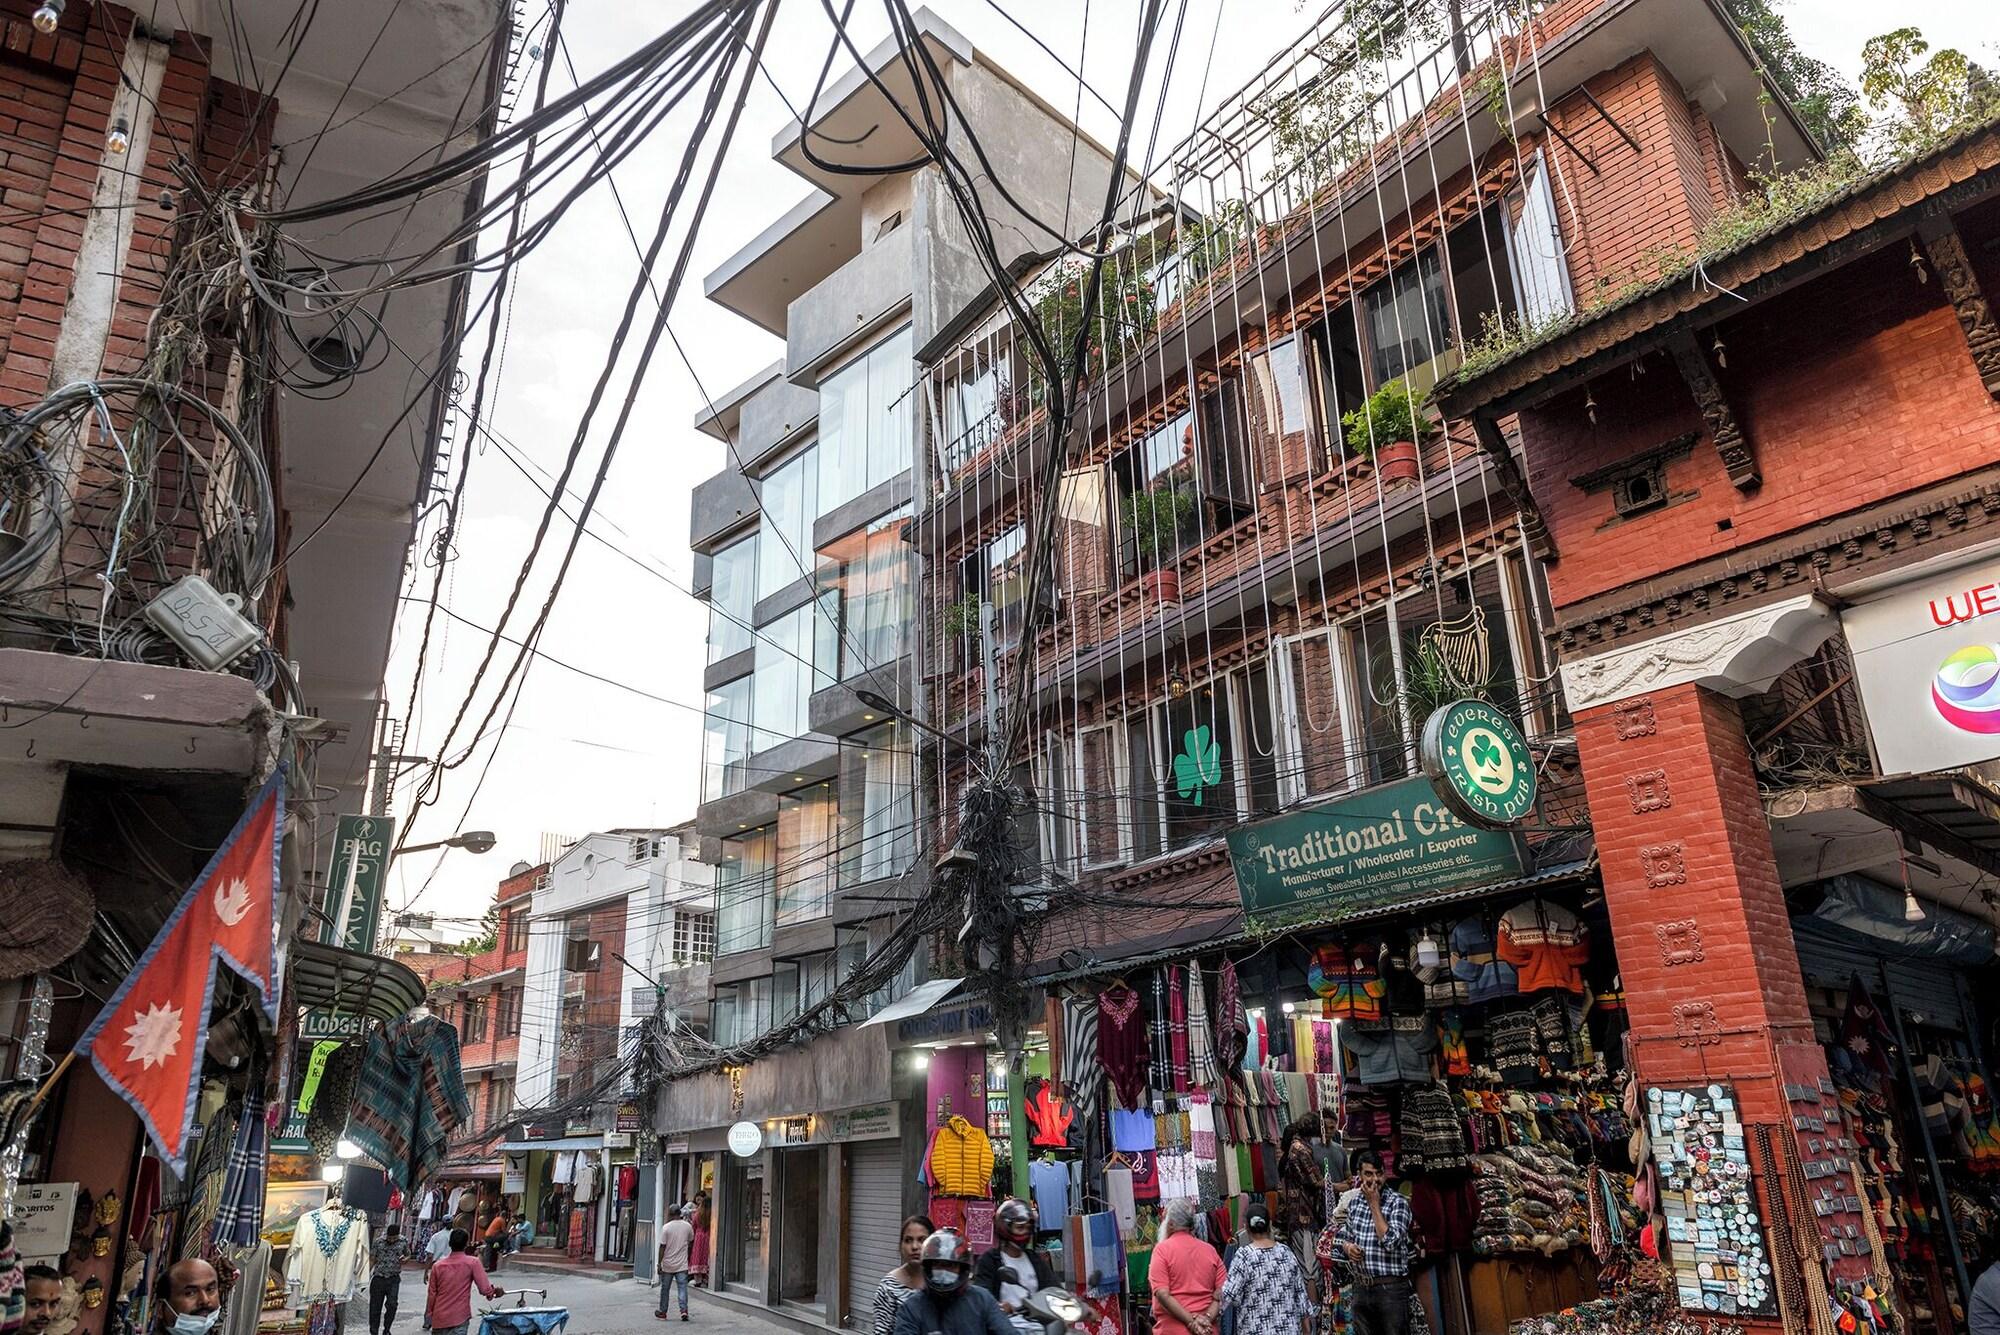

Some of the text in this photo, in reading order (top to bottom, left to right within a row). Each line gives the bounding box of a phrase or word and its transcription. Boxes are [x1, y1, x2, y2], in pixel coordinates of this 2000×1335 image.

[1929, 584, 2000, 625] WE
[1260, 809, 1408, 874] Traditional
[1354, 848, 1415, 870] Wholesaler
[1427, 833, 1478, 853] Exporter
[1294, 886, 1325, 899] Woollen
[1455, 854, 1473, 864] etc.
[308, 1016, 359, 1034] LODGE
